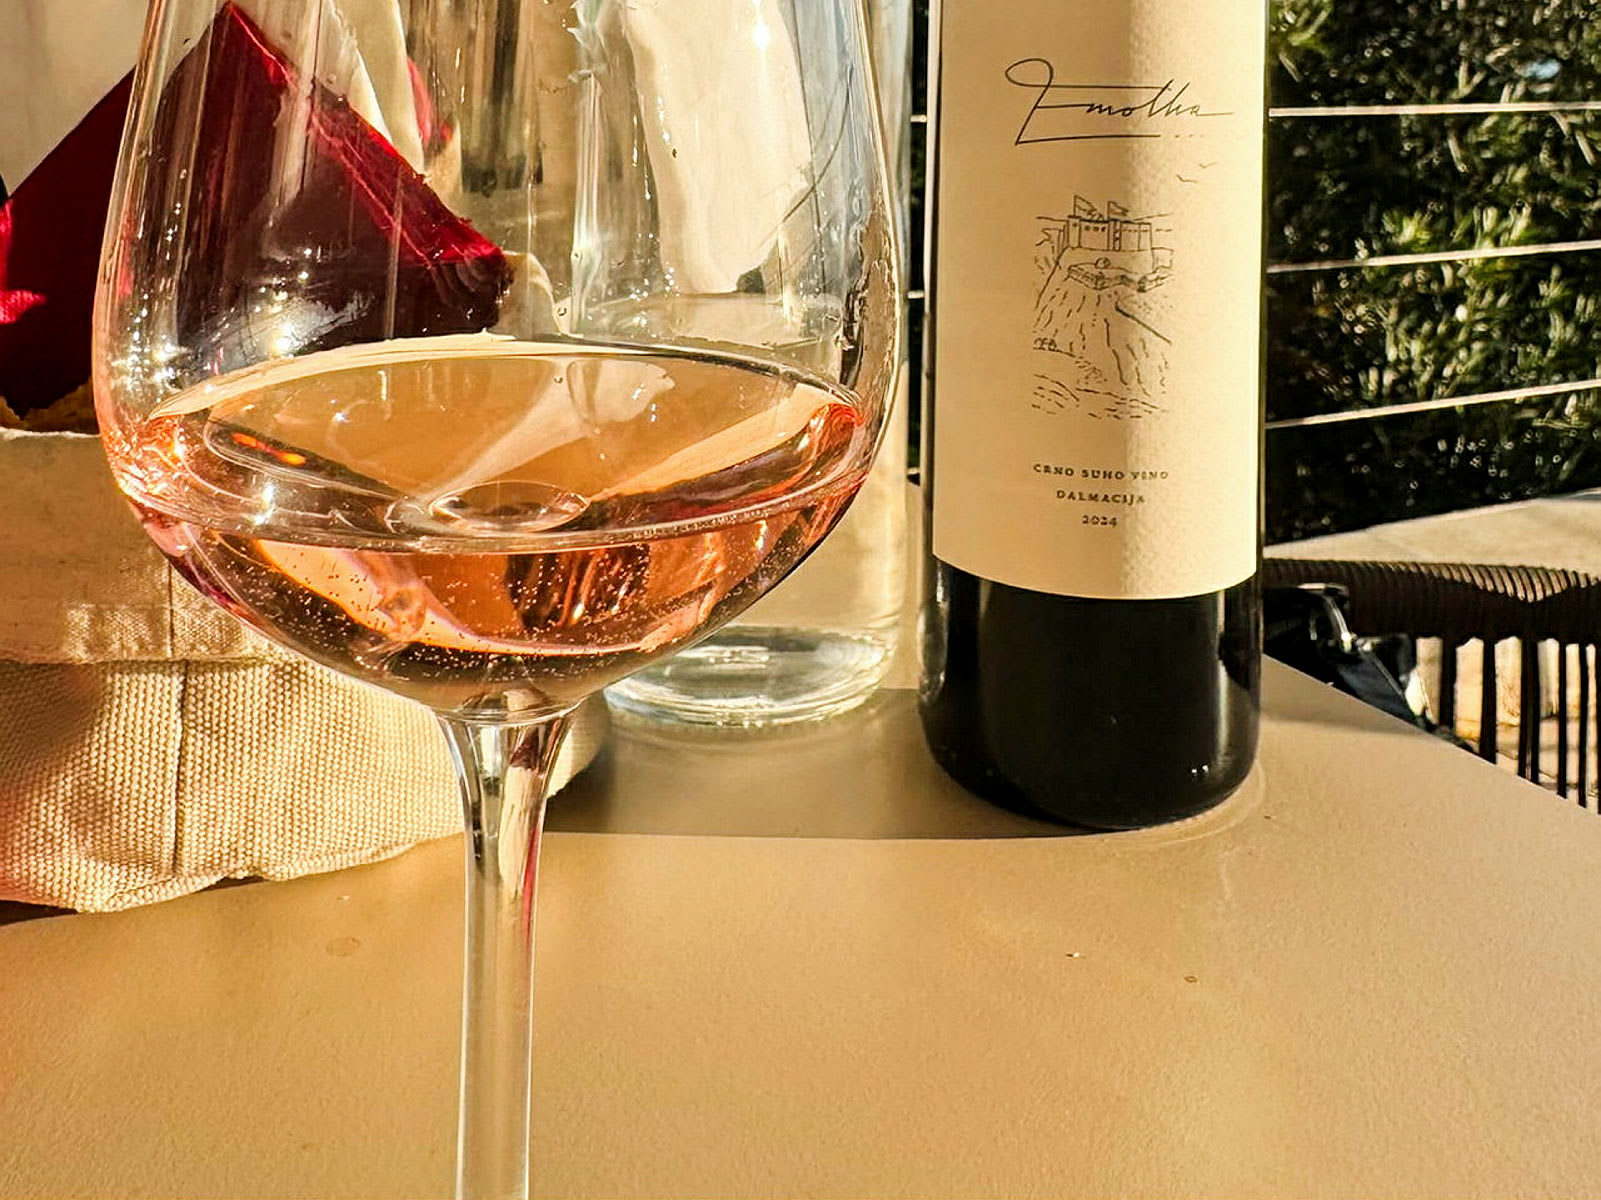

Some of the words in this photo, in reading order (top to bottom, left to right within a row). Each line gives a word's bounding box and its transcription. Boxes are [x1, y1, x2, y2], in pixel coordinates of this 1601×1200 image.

[1033, 464, 1074, 477] CRNO
[1081, 469, 1124, 480] SUHO
[1131, 471, 1169, 480] VINO
[1056, 490, 1145, 506] DALMACIJA
[1082, 515, 1118, 527] 2024
